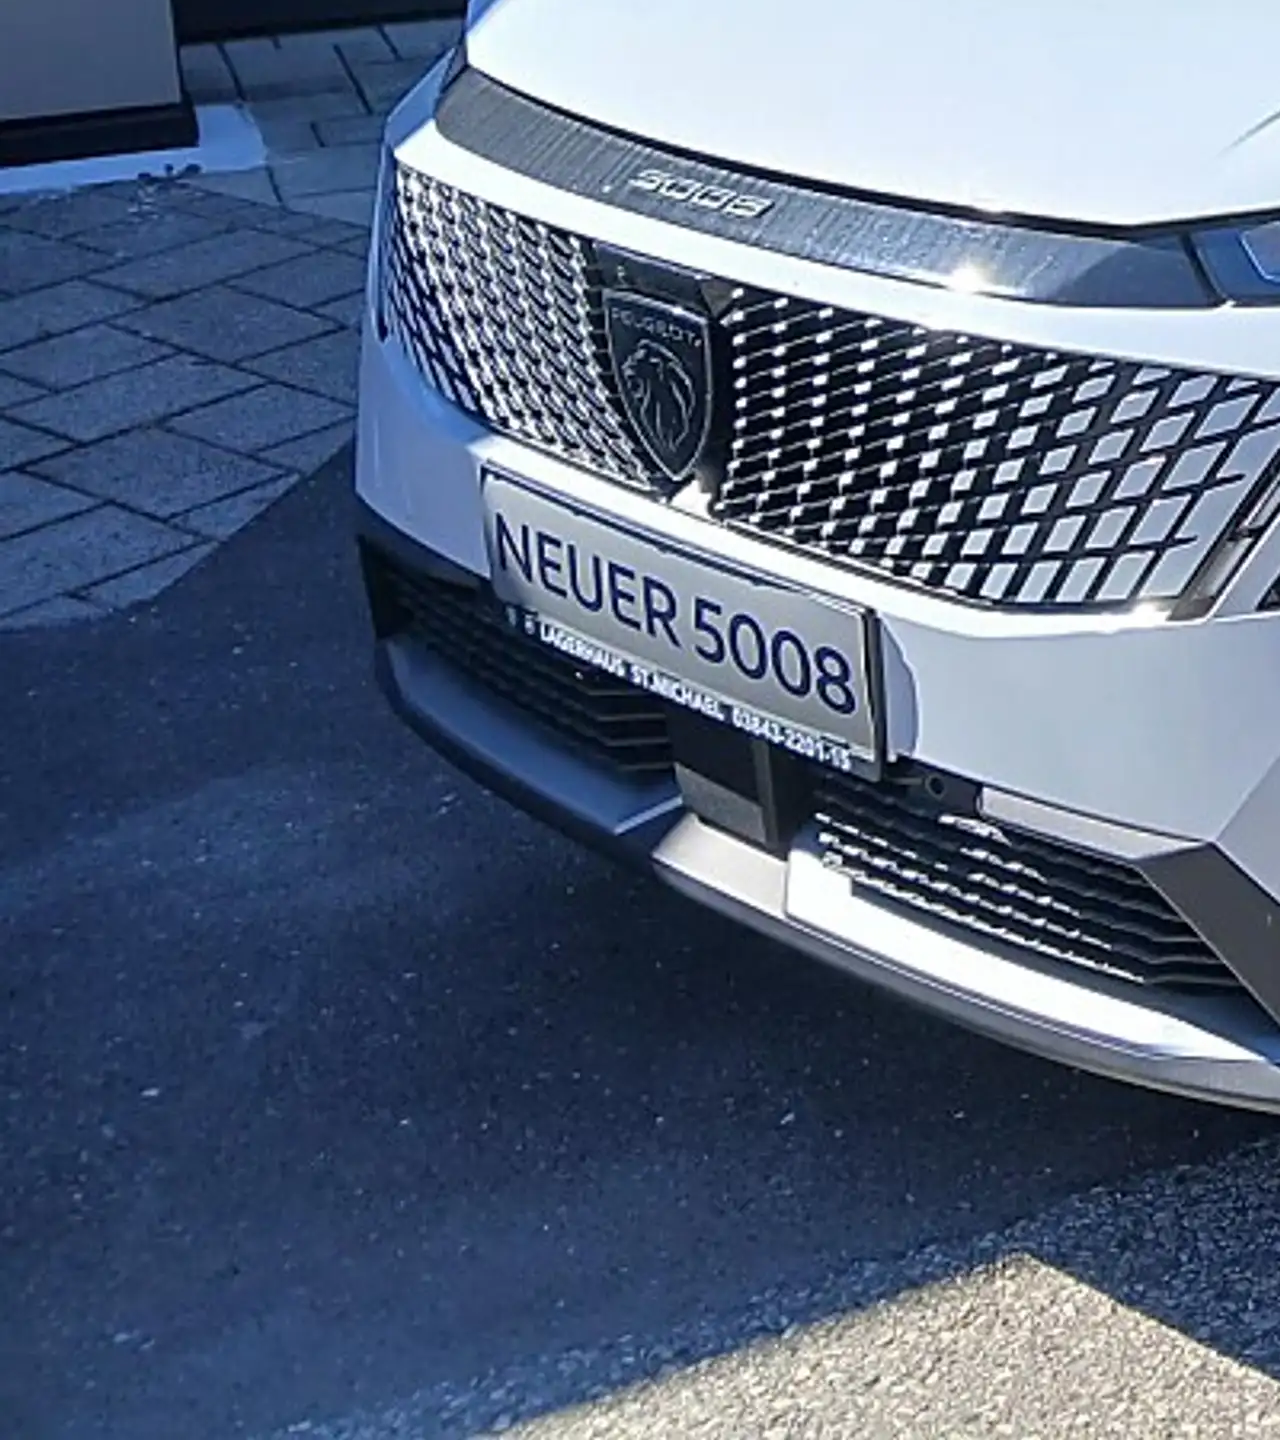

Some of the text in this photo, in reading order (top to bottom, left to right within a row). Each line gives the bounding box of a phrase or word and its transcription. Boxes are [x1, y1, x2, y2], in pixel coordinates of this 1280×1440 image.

[628, 168, 775, 219] 5008
[497, 512, 857, 715] NEUER 5008
[540, 625, 627, 678] LAGERHAUS
